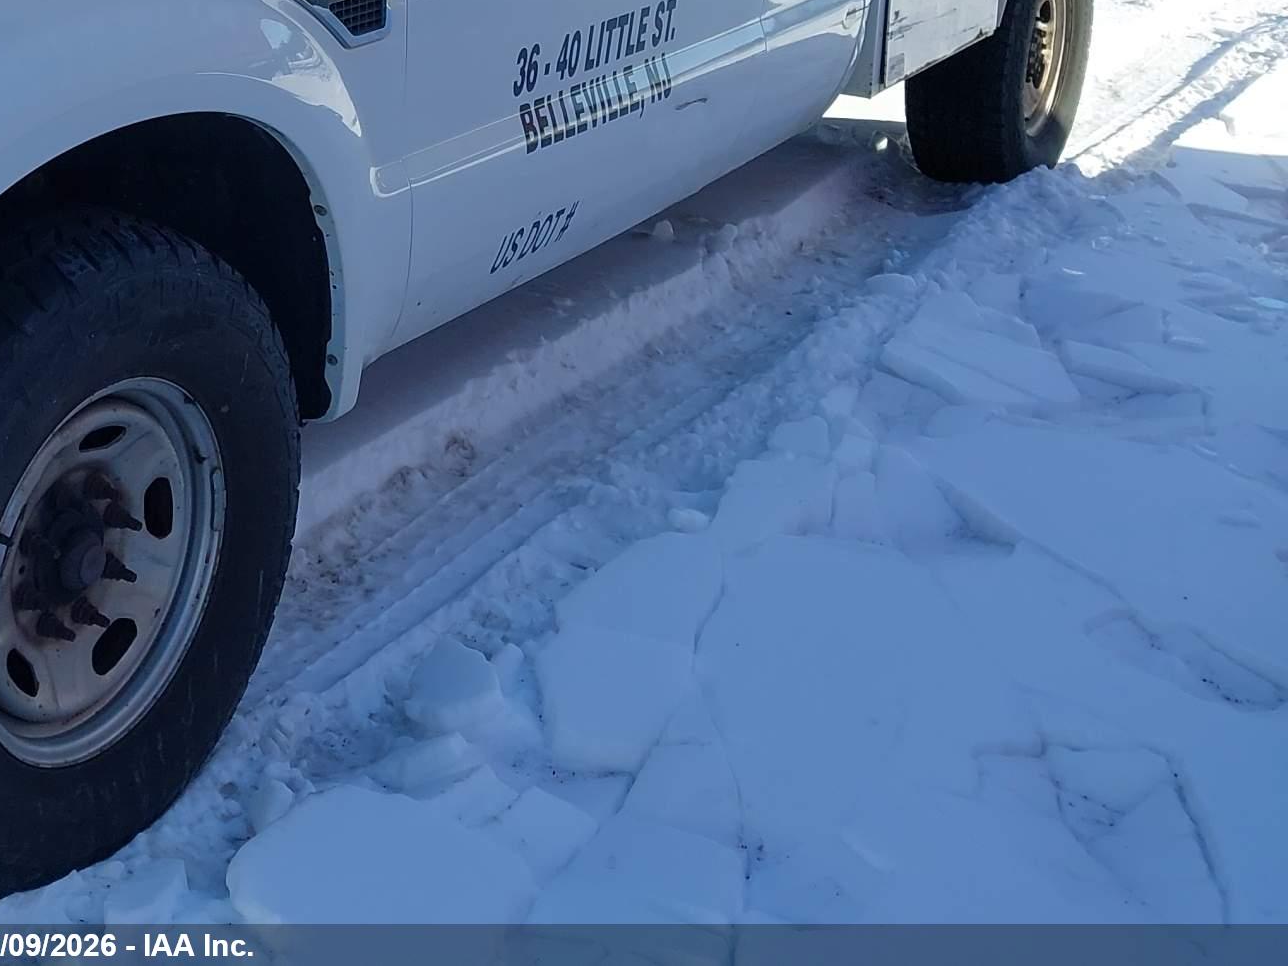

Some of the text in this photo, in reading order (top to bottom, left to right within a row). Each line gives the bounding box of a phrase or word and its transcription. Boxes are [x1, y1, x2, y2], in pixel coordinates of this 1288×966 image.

[513, 43, 541, 98] 36
[555, 29, 582, 81] 40
[583, 5, 651, 73] LITTLE
[519, 52, 672, 155] BELLEVILLE, NJ
[489, 226, 526, 275] US
